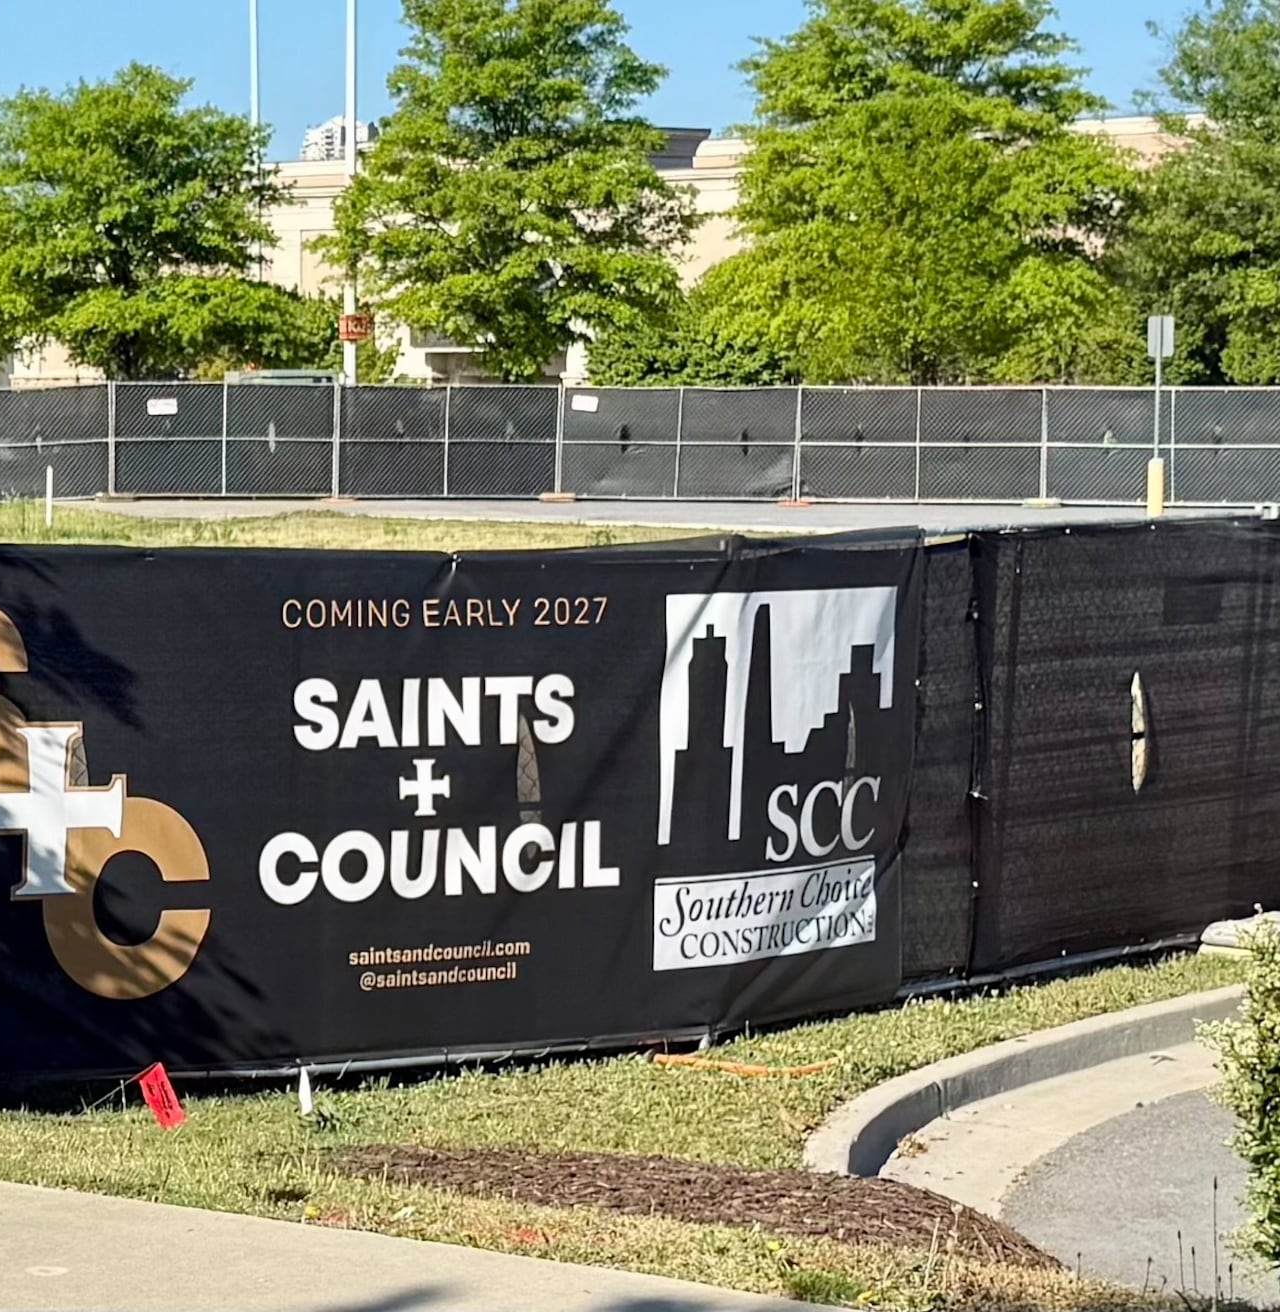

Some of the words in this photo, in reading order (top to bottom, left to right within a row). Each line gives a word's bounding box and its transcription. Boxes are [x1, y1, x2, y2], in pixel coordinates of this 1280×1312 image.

[282, 598, 410, 628] COMING
[422, 597, 521, 627] EARLY
[533, 596, 608, 626] 2027
[293, 673, 575, 751] SAINTS
[765, 776, 881, 863] SCC
[259, 820, 620, 905] COUNCIL
[659, 881, 794, 937] Southern
[800, 867, 873, 909] Choice
[349, 940, 530, 966] saintsandcouncil.com
[680, 909, 867, 960] CONSTRUCTION
[360, 961, 517, 991] @saintsandcouncil
